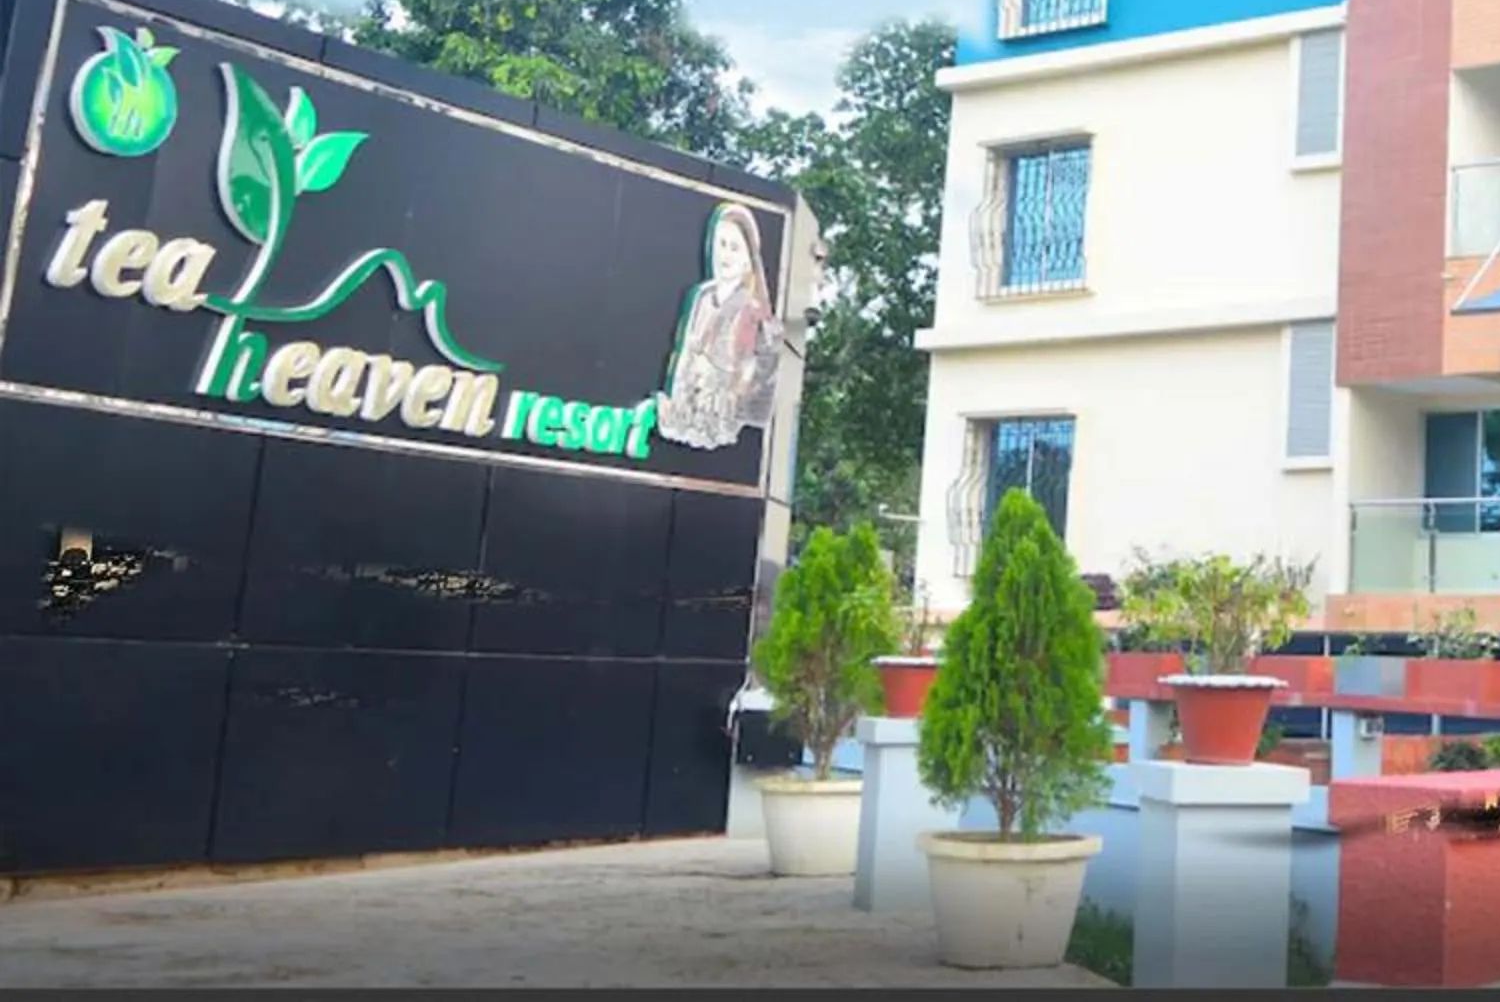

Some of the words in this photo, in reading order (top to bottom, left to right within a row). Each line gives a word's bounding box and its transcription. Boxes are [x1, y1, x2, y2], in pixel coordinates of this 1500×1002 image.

[46, 200, 217, 312] tea
[195, 316, 500, 438] heaven
[503, 391, 660, 460] resort
